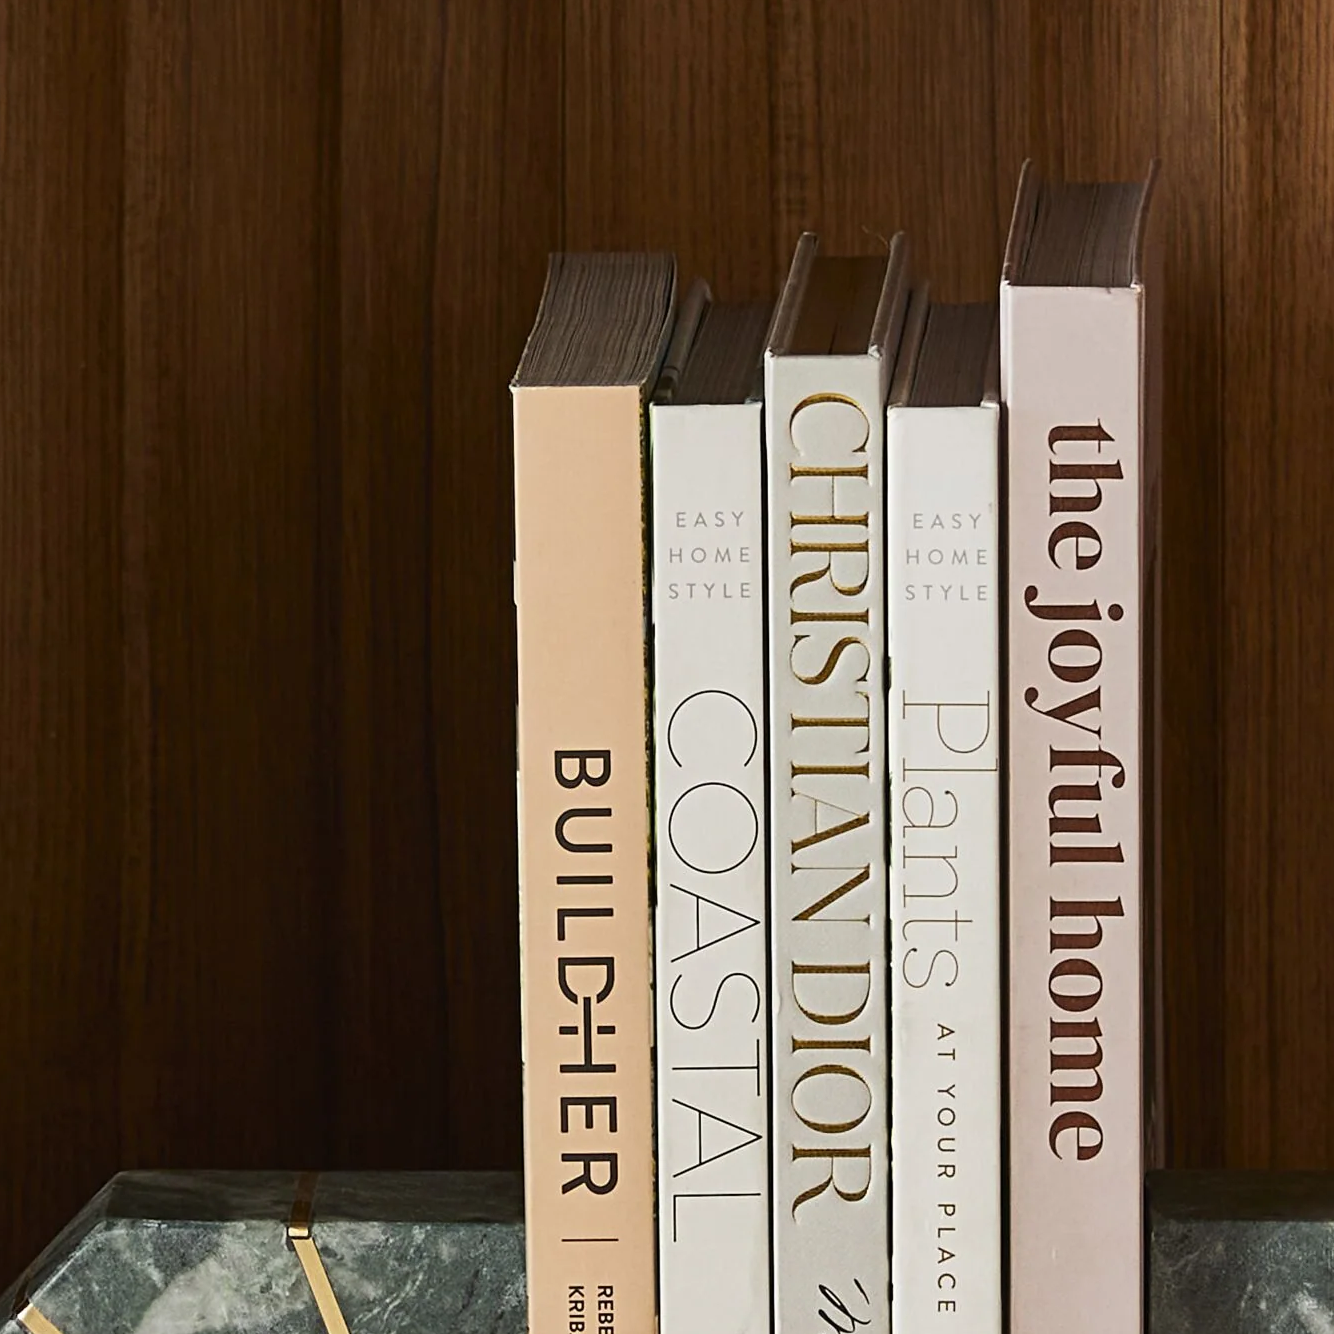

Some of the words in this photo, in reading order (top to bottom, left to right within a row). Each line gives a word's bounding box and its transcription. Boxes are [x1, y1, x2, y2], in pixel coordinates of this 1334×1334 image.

[676, 511, 743, 527] EASY
[914, 513, 981, 529] EASY
[1048, 419, 1123, 570] the
[669, 583, 751, 599] STYLE
[670, 547, 749, 563] HOME
[906, 585, 987, 601] STYLE
[907, 549, 987, 565] HOME
[789, 394, 870, 925] CHRISTIAN
[1024, 585, 1125, 867] joyful
[902, 690, 998, 989] Plants
[668, 690, 762, 1243] COASTAL
[938, 1024, 955, 1060] AT
[1049, 896, 1124, 1160] home
[791, 961, 871, 1218] DIOR
[938, 1084, 955, 1178] YOUR
[938, 1204, 956, 1312] PLACE
